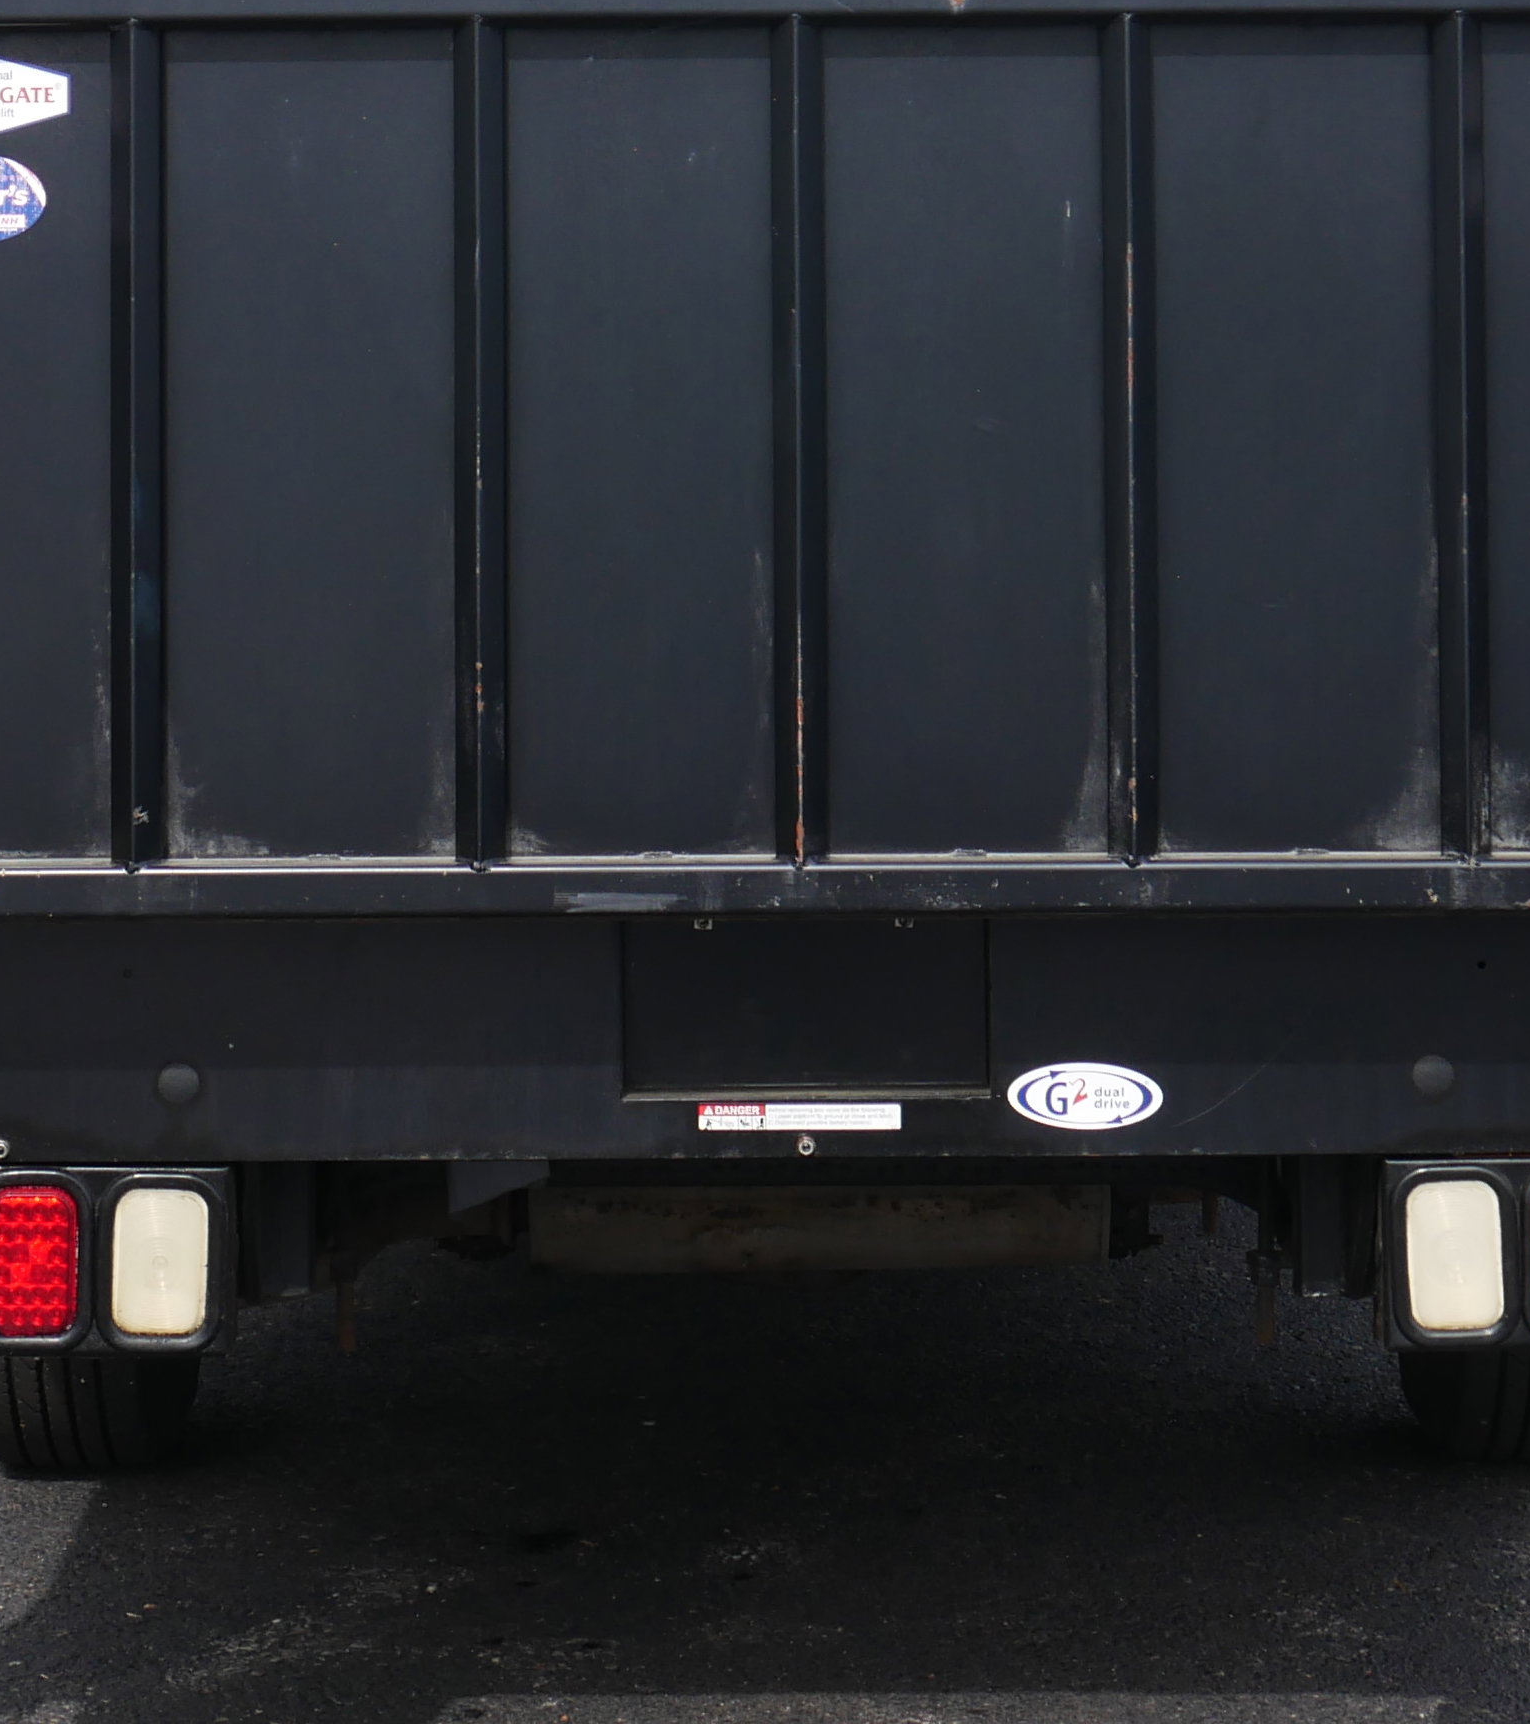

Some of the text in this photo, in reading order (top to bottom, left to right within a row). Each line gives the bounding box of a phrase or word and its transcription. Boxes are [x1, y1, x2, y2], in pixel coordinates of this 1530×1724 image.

[0, 86, 56, 103] GATE
[0, 108, 15, 118] lift
[0, 217, 19, 225] NH
[1094, 1087, 1125, 1097] dual
[1094, 1098, 1130, 1109] drive
[714, 1105, 761, 1115] DANGER
